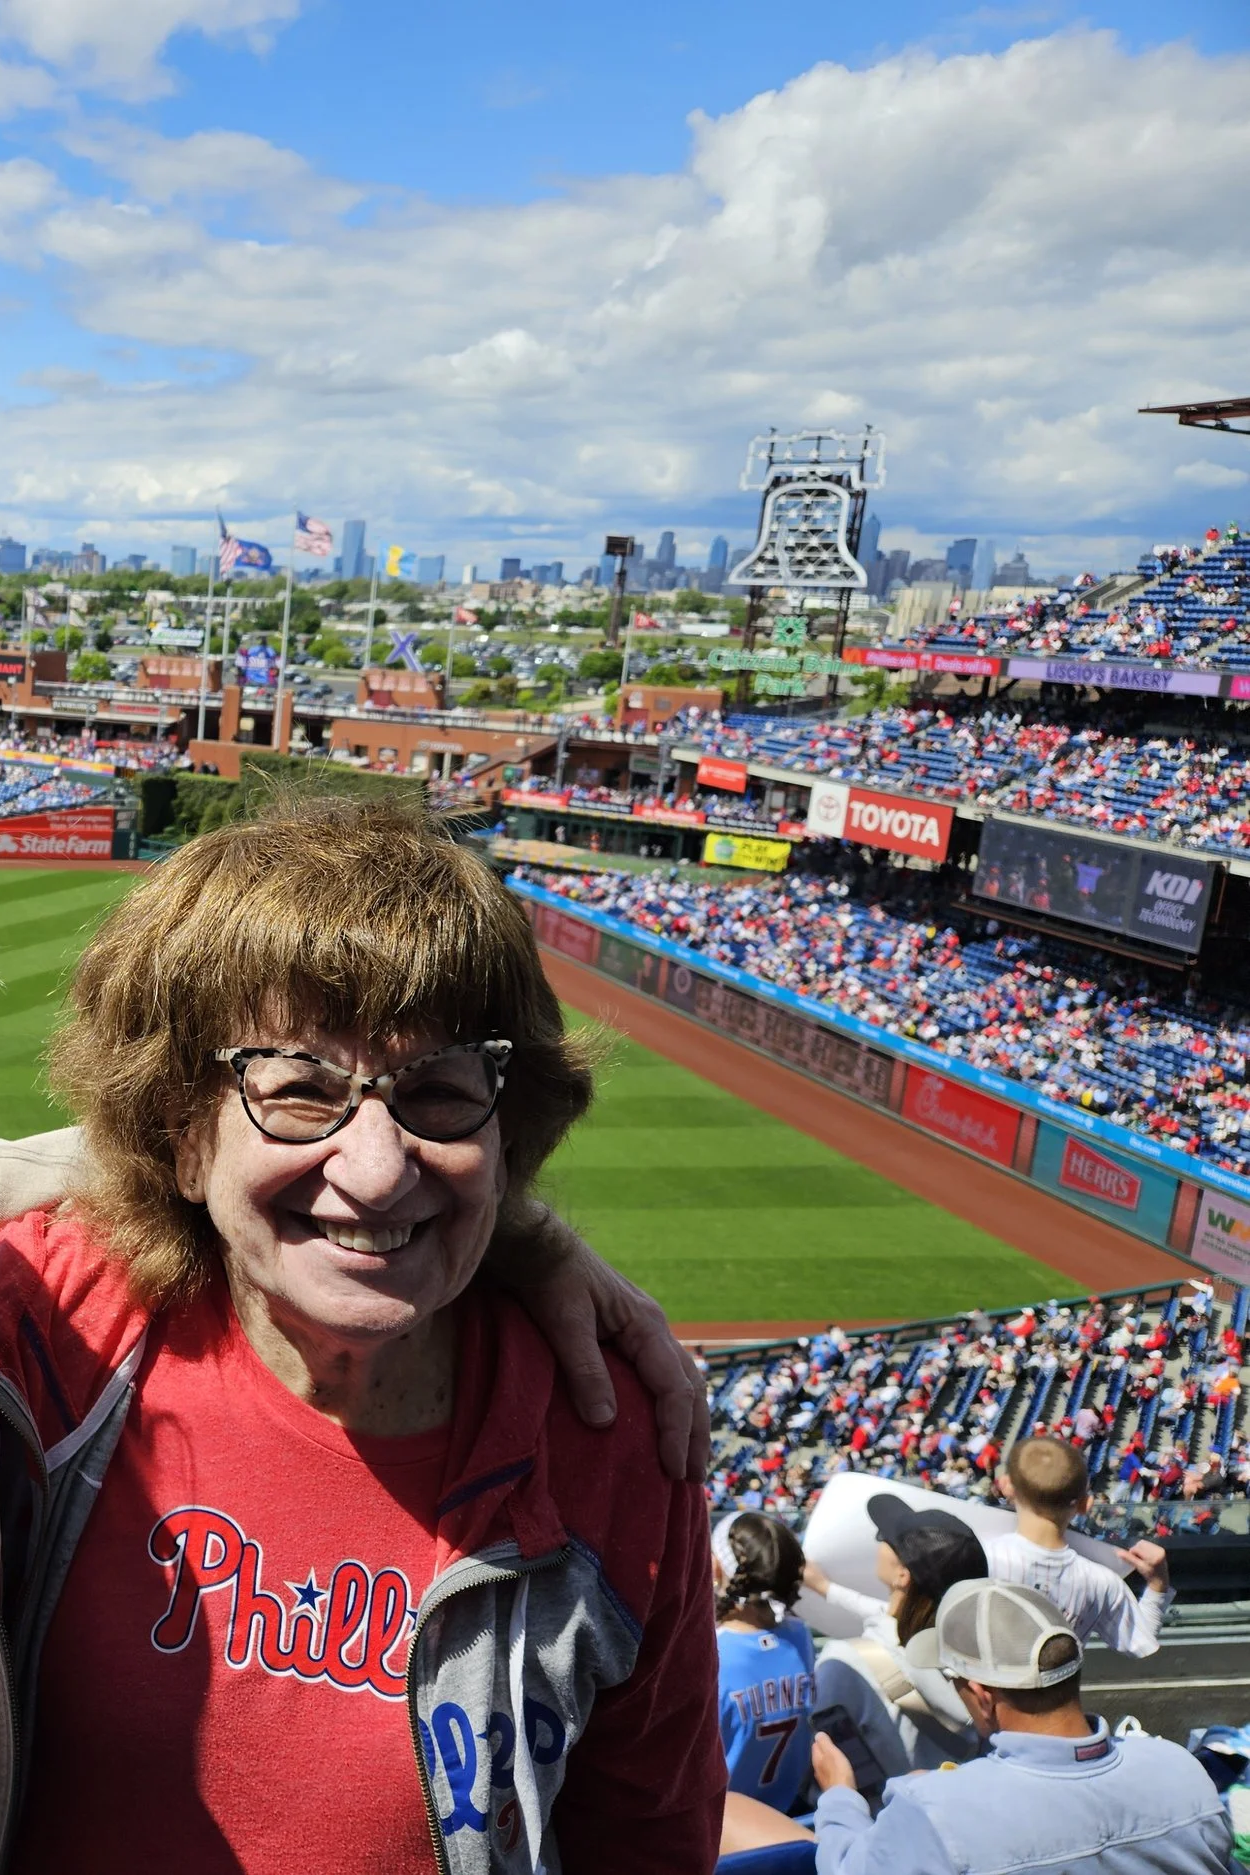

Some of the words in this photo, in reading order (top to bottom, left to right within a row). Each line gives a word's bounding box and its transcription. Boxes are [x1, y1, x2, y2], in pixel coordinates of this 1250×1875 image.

[707, 648, 801, 673] Citizens
[1045, 662, 1105, 683] LISCIO'S
[1109, 668, 1174, 690] BAKERY
[754, 672, 807, 697] Park
[850, 800, 940, 847] TOYOTA
[1145, 870, 1204, 905] KDI
[1069, 1151, 1130, 1199] HERR'S
[148, 1504, 418, 1703] Phill
[755, 1714, 800, 1788] 7
